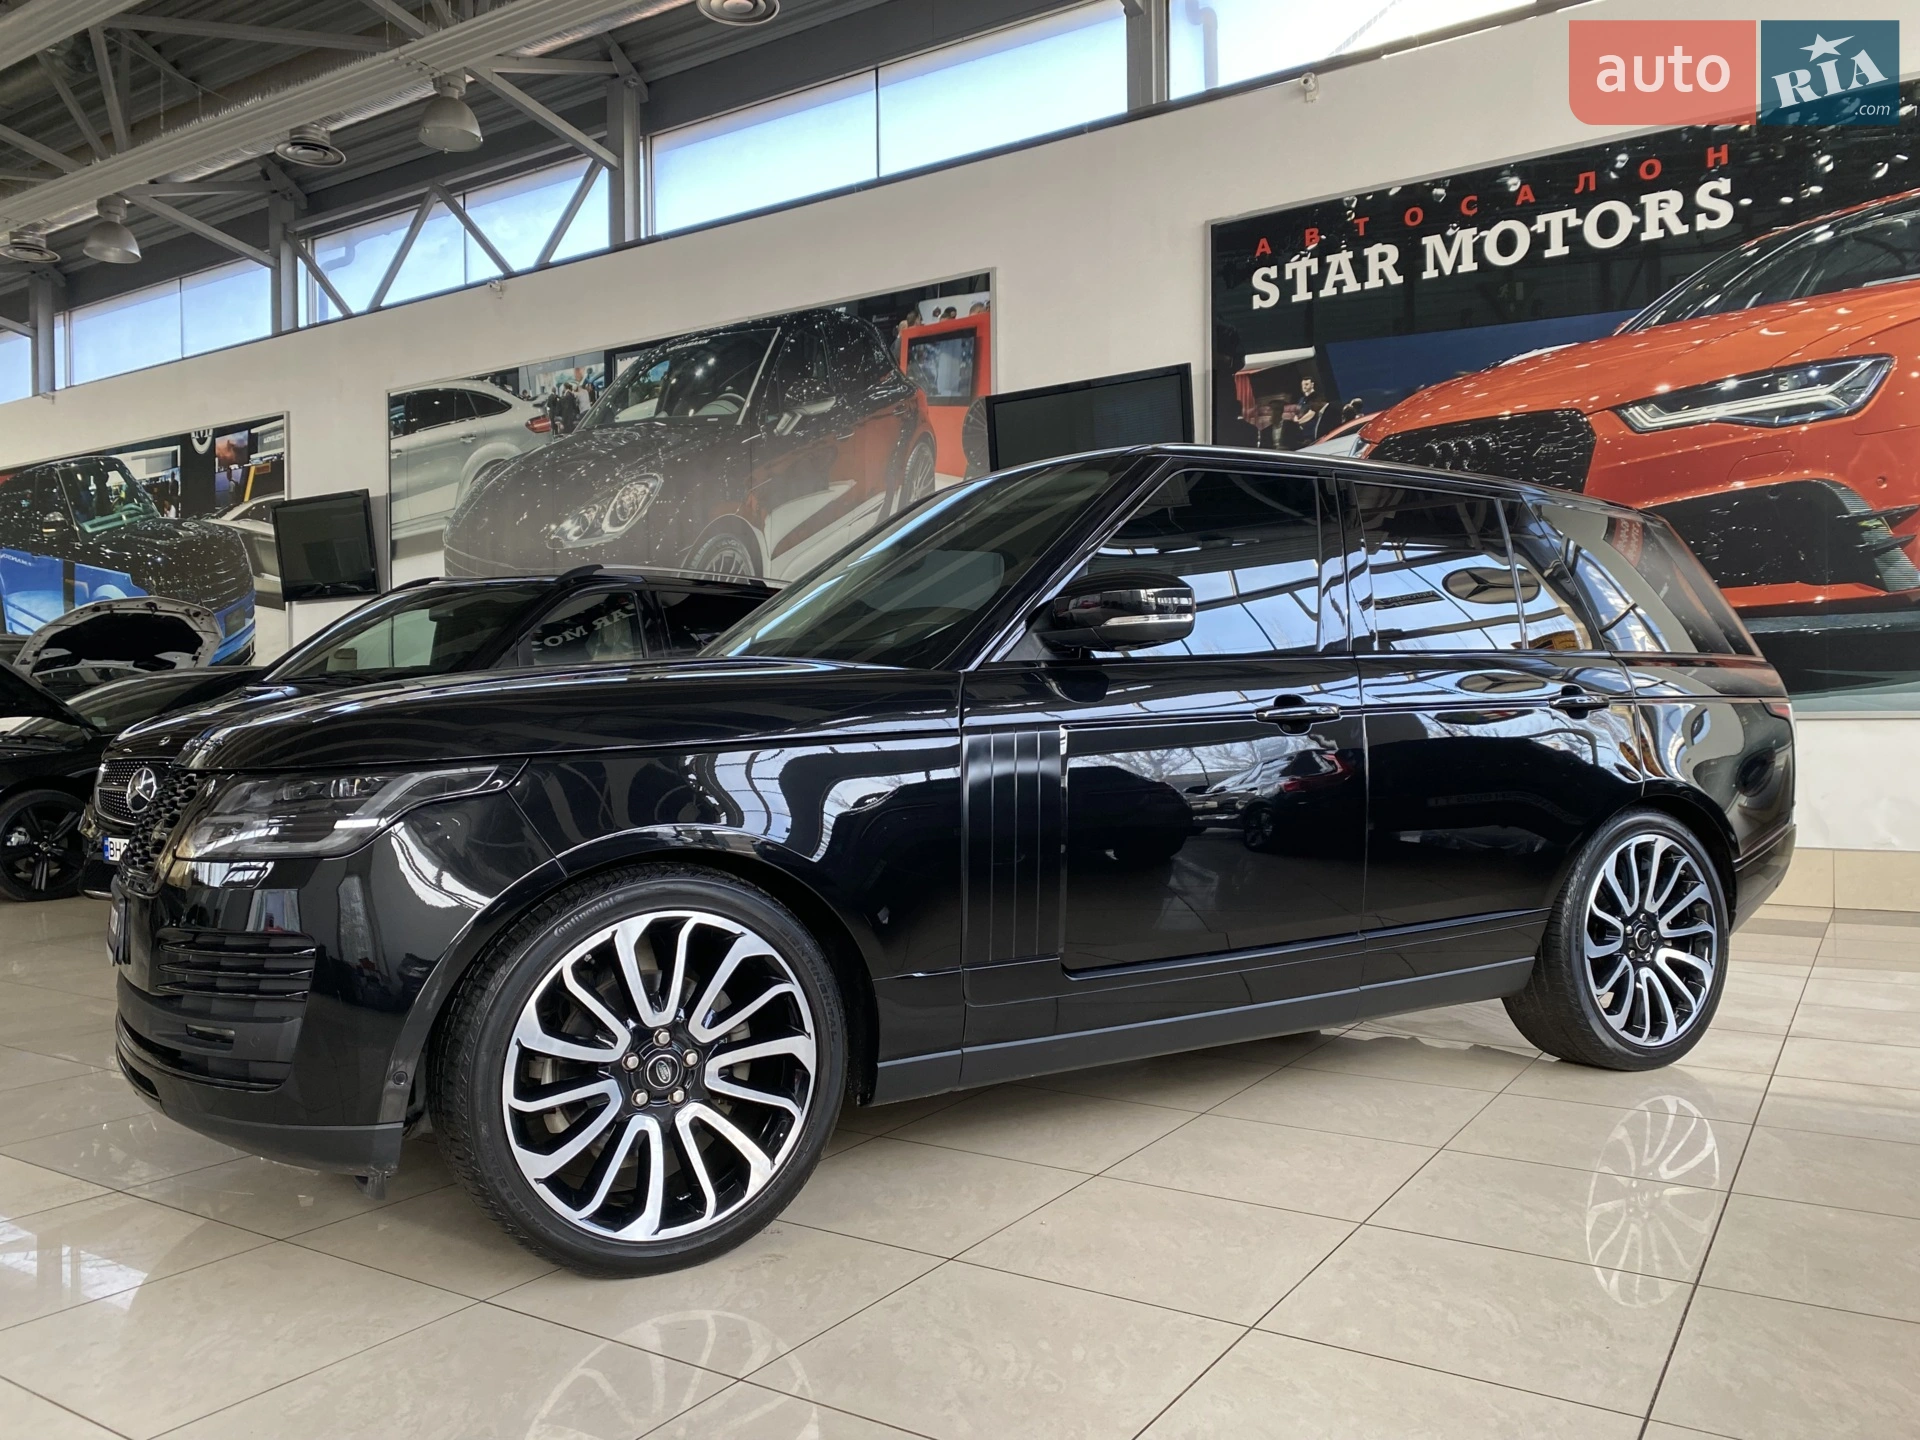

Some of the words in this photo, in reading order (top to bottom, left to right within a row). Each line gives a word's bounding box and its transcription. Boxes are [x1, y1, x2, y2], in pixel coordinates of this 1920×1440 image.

[1251, 243, 1404, 310] STAR
[1421, 177, 1734, 280] MOTORS
[553, 896, 615, 938] Continental
